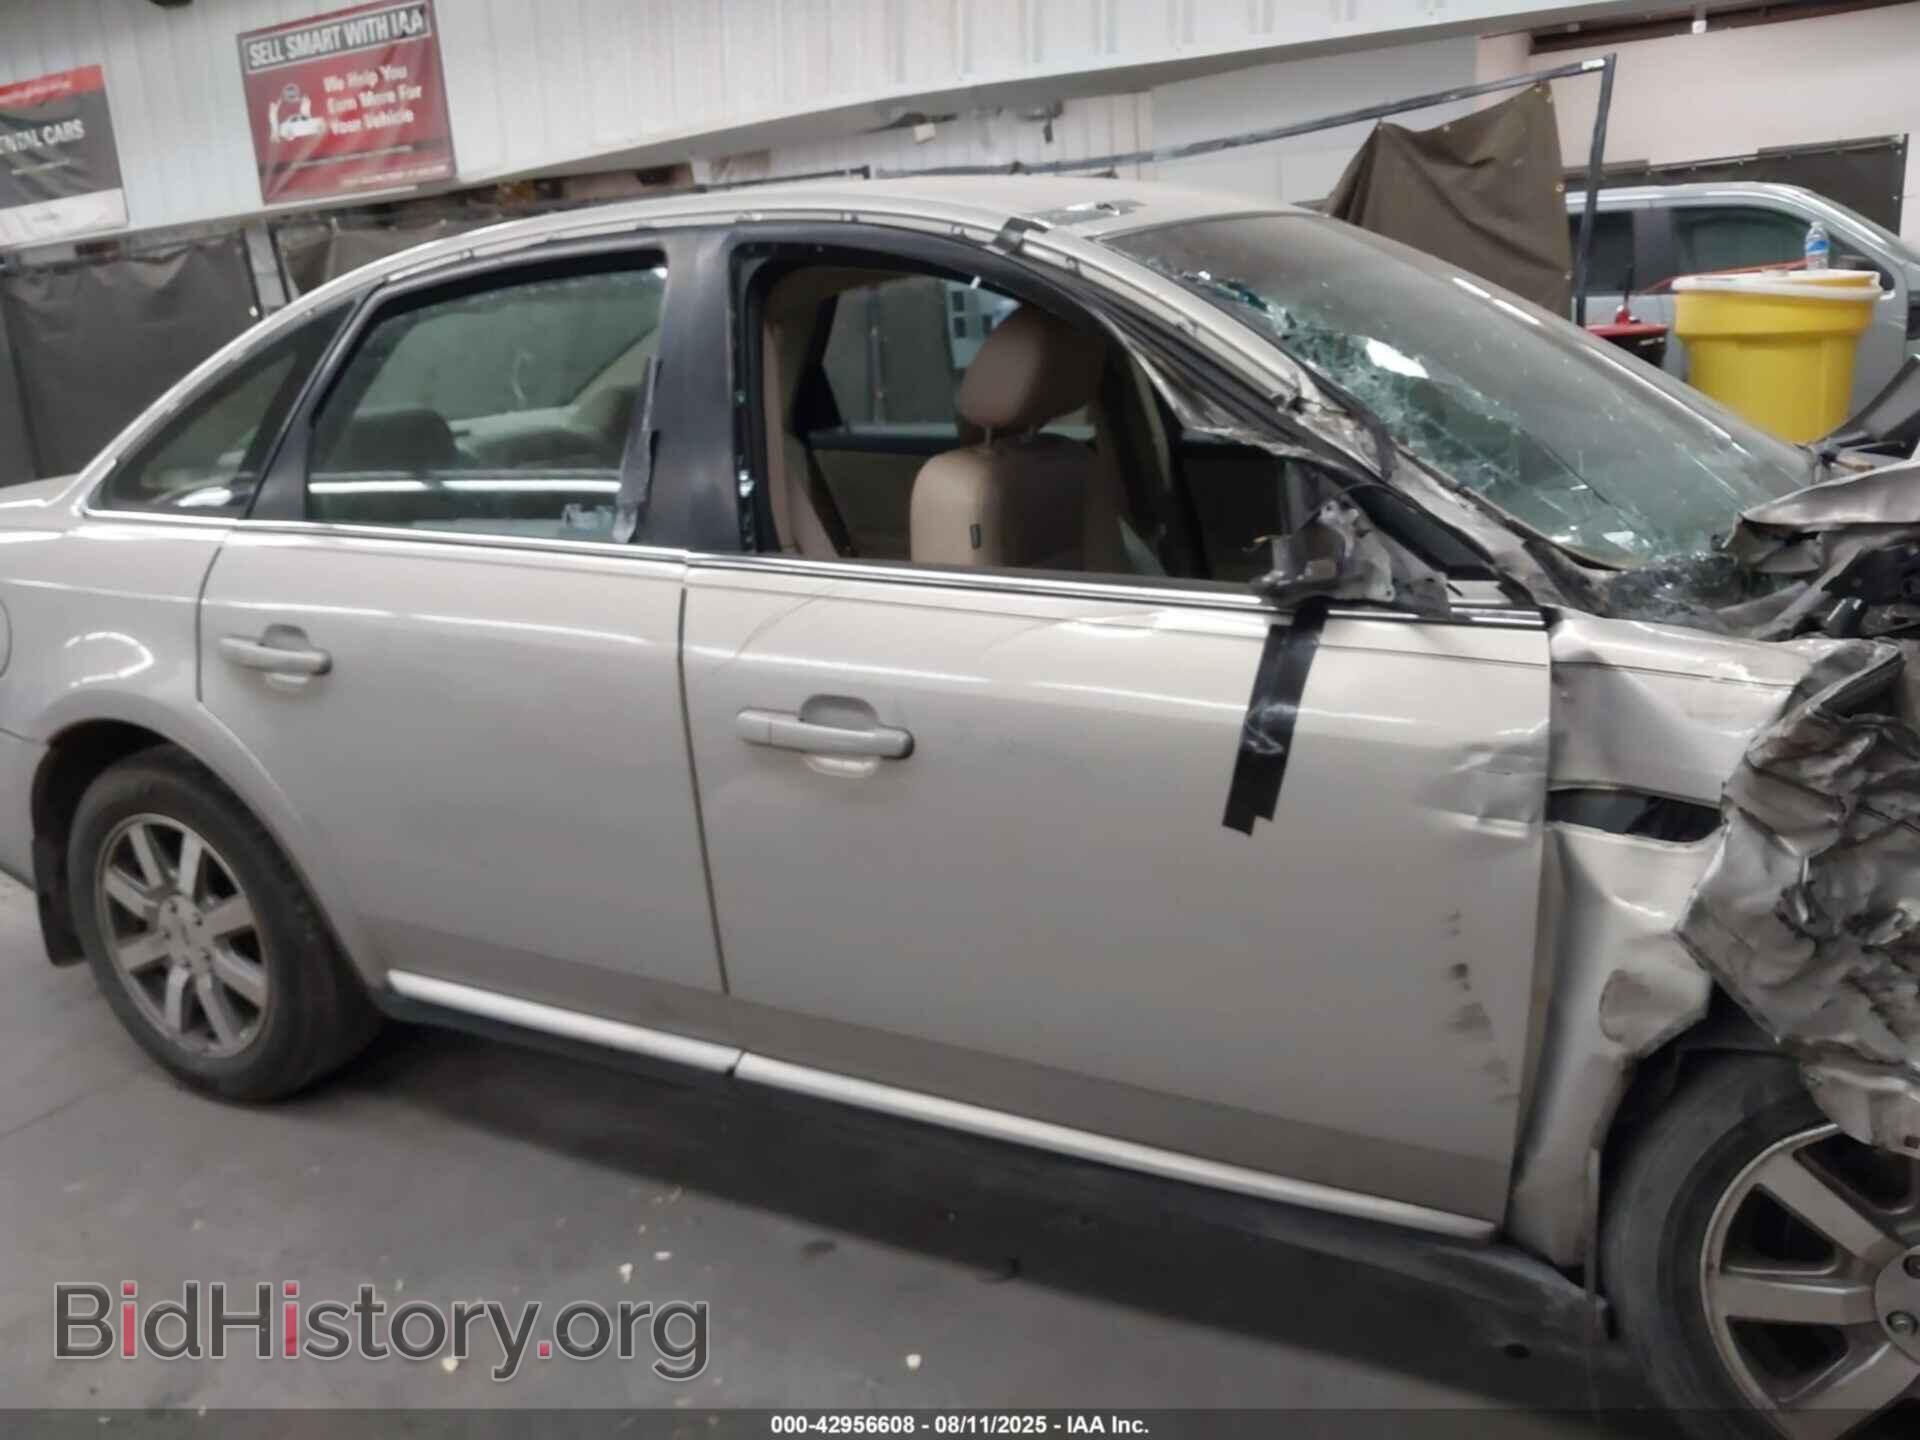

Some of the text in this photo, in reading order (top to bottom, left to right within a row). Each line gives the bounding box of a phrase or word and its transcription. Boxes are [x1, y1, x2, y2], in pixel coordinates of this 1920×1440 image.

[249, 8, 424, 67] SELL SMART WITH IAA
[323, 75, 345, 93] We
[379, 65, 408, 81] You
[397, 84, 423, 101] For
[42, 118, 85, 145] CARS
